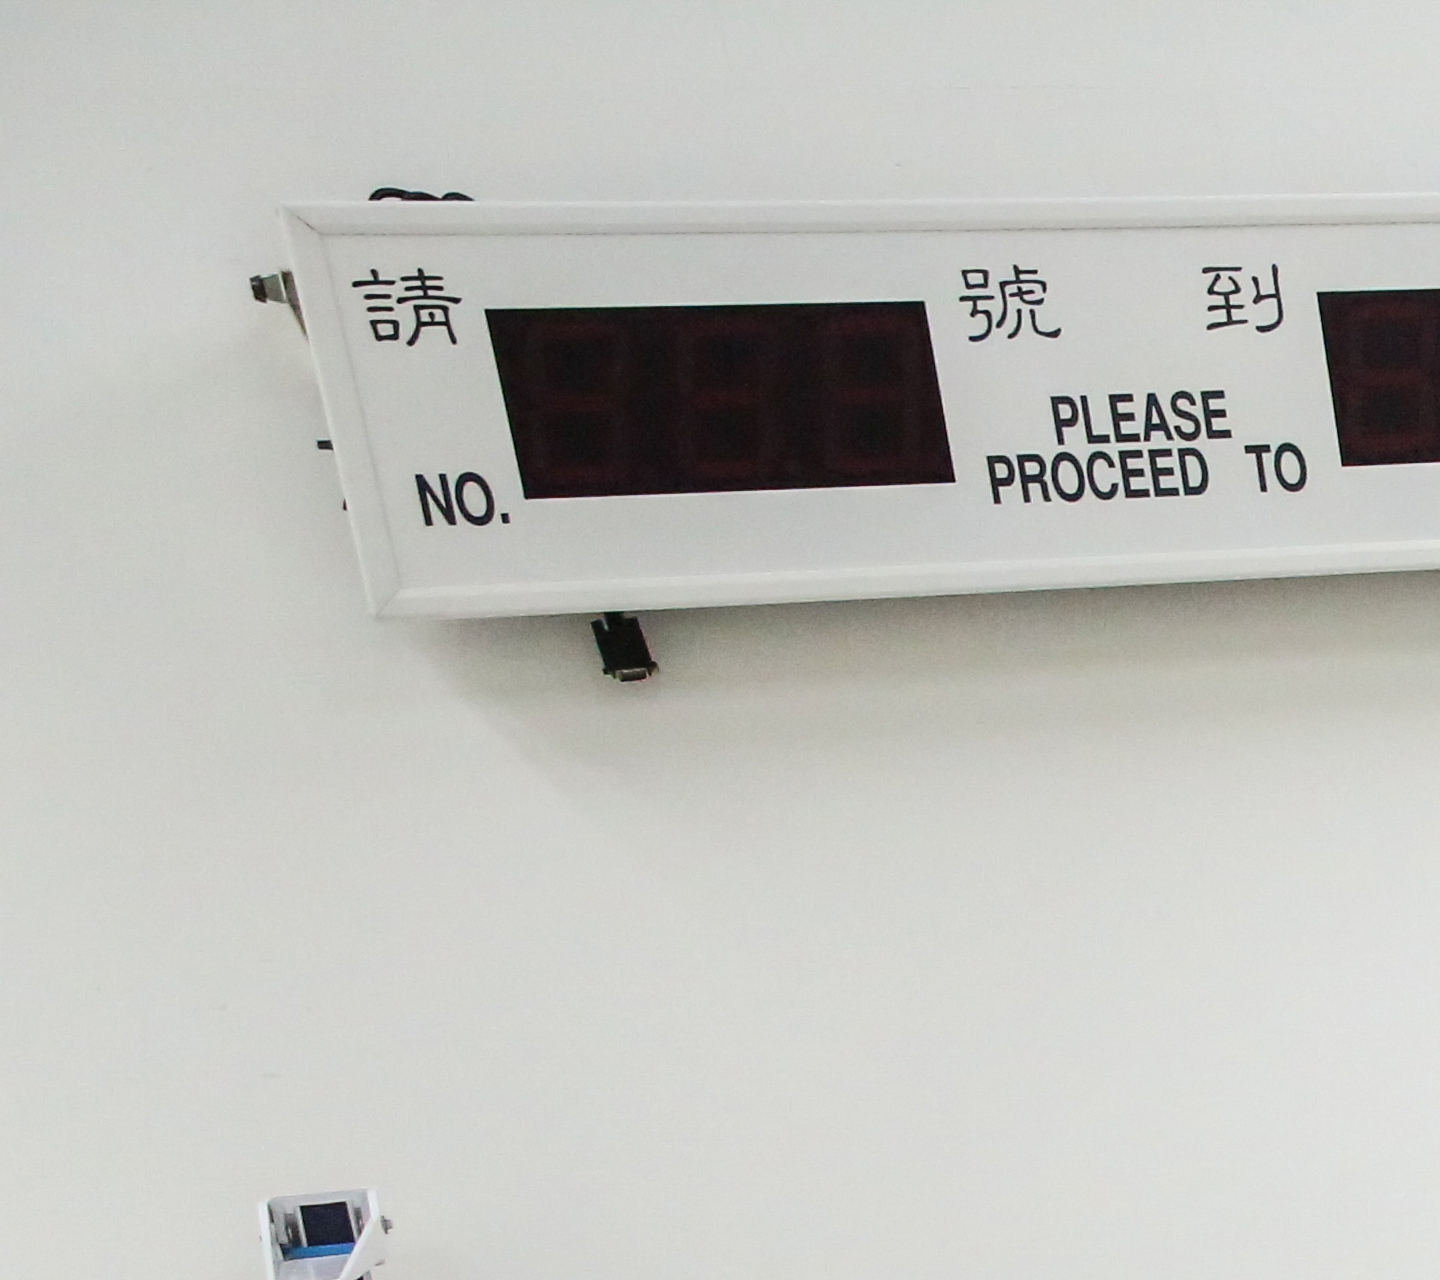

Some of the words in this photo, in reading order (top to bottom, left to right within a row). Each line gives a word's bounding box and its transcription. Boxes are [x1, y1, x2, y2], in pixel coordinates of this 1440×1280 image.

[352, 267, 463, 347] 請
[959, 263, 1063, 342] 號
[1201, 263, 1286, 336] 到
[1051, 389, 1233, 447] PLEASE
[414, 470, 511, 528] NO.
[986, 444, 1210, 506] PROCEED
[1244, 440, 1310, 496] TO
